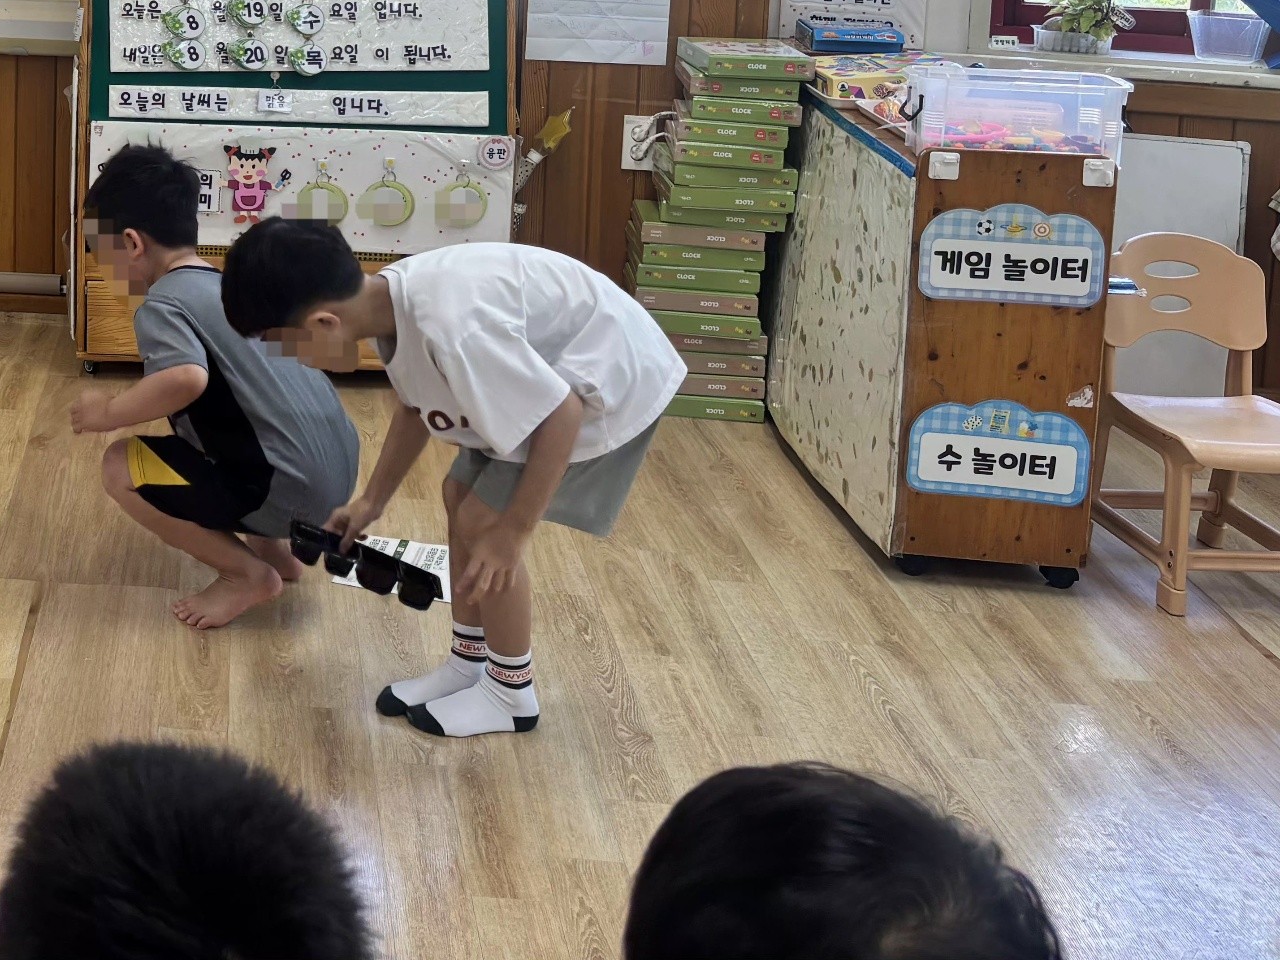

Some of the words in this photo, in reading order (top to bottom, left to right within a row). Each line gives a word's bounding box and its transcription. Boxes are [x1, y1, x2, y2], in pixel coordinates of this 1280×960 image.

[121, 0, 162, 20] 오늘은
[186, 14, 200, 31] 8
[244, 2, 264, 17] 19
[269, 2, 283, 22] 일
[302, 10, 320, 29] 수
[330, 2, 358, 21] 요일
[374, 0, 422, 21] 입니다.
[123, 44, 164, 65] 내일은
[187, 45, 200, 62] 8
[245, 46, 264, 63] 20
[274, 45, 288, 65] 일
[305, 50, 323, 69] 목
[331, 44, 358, 64] 요일
[375, 47, 389, 61] 이
[404, 44, 452, 64] 됩니다.
[119, 91, 165, 112] 오늘의
[182, 92, 228, 112] 날씨는
[265, 95, 285, 109] 맑음
[332, 96, 389, 116] 입니다.
[717, 128, 737, 136] CLOCK
[485, 146, 507, 161] 융판
[934, 250, 992, 279] 게임
[1002, 253, 1089, 282] 놀이터
[937, 444, 963, 472] 수
[971, 447, 1057, 480] 놀이터
